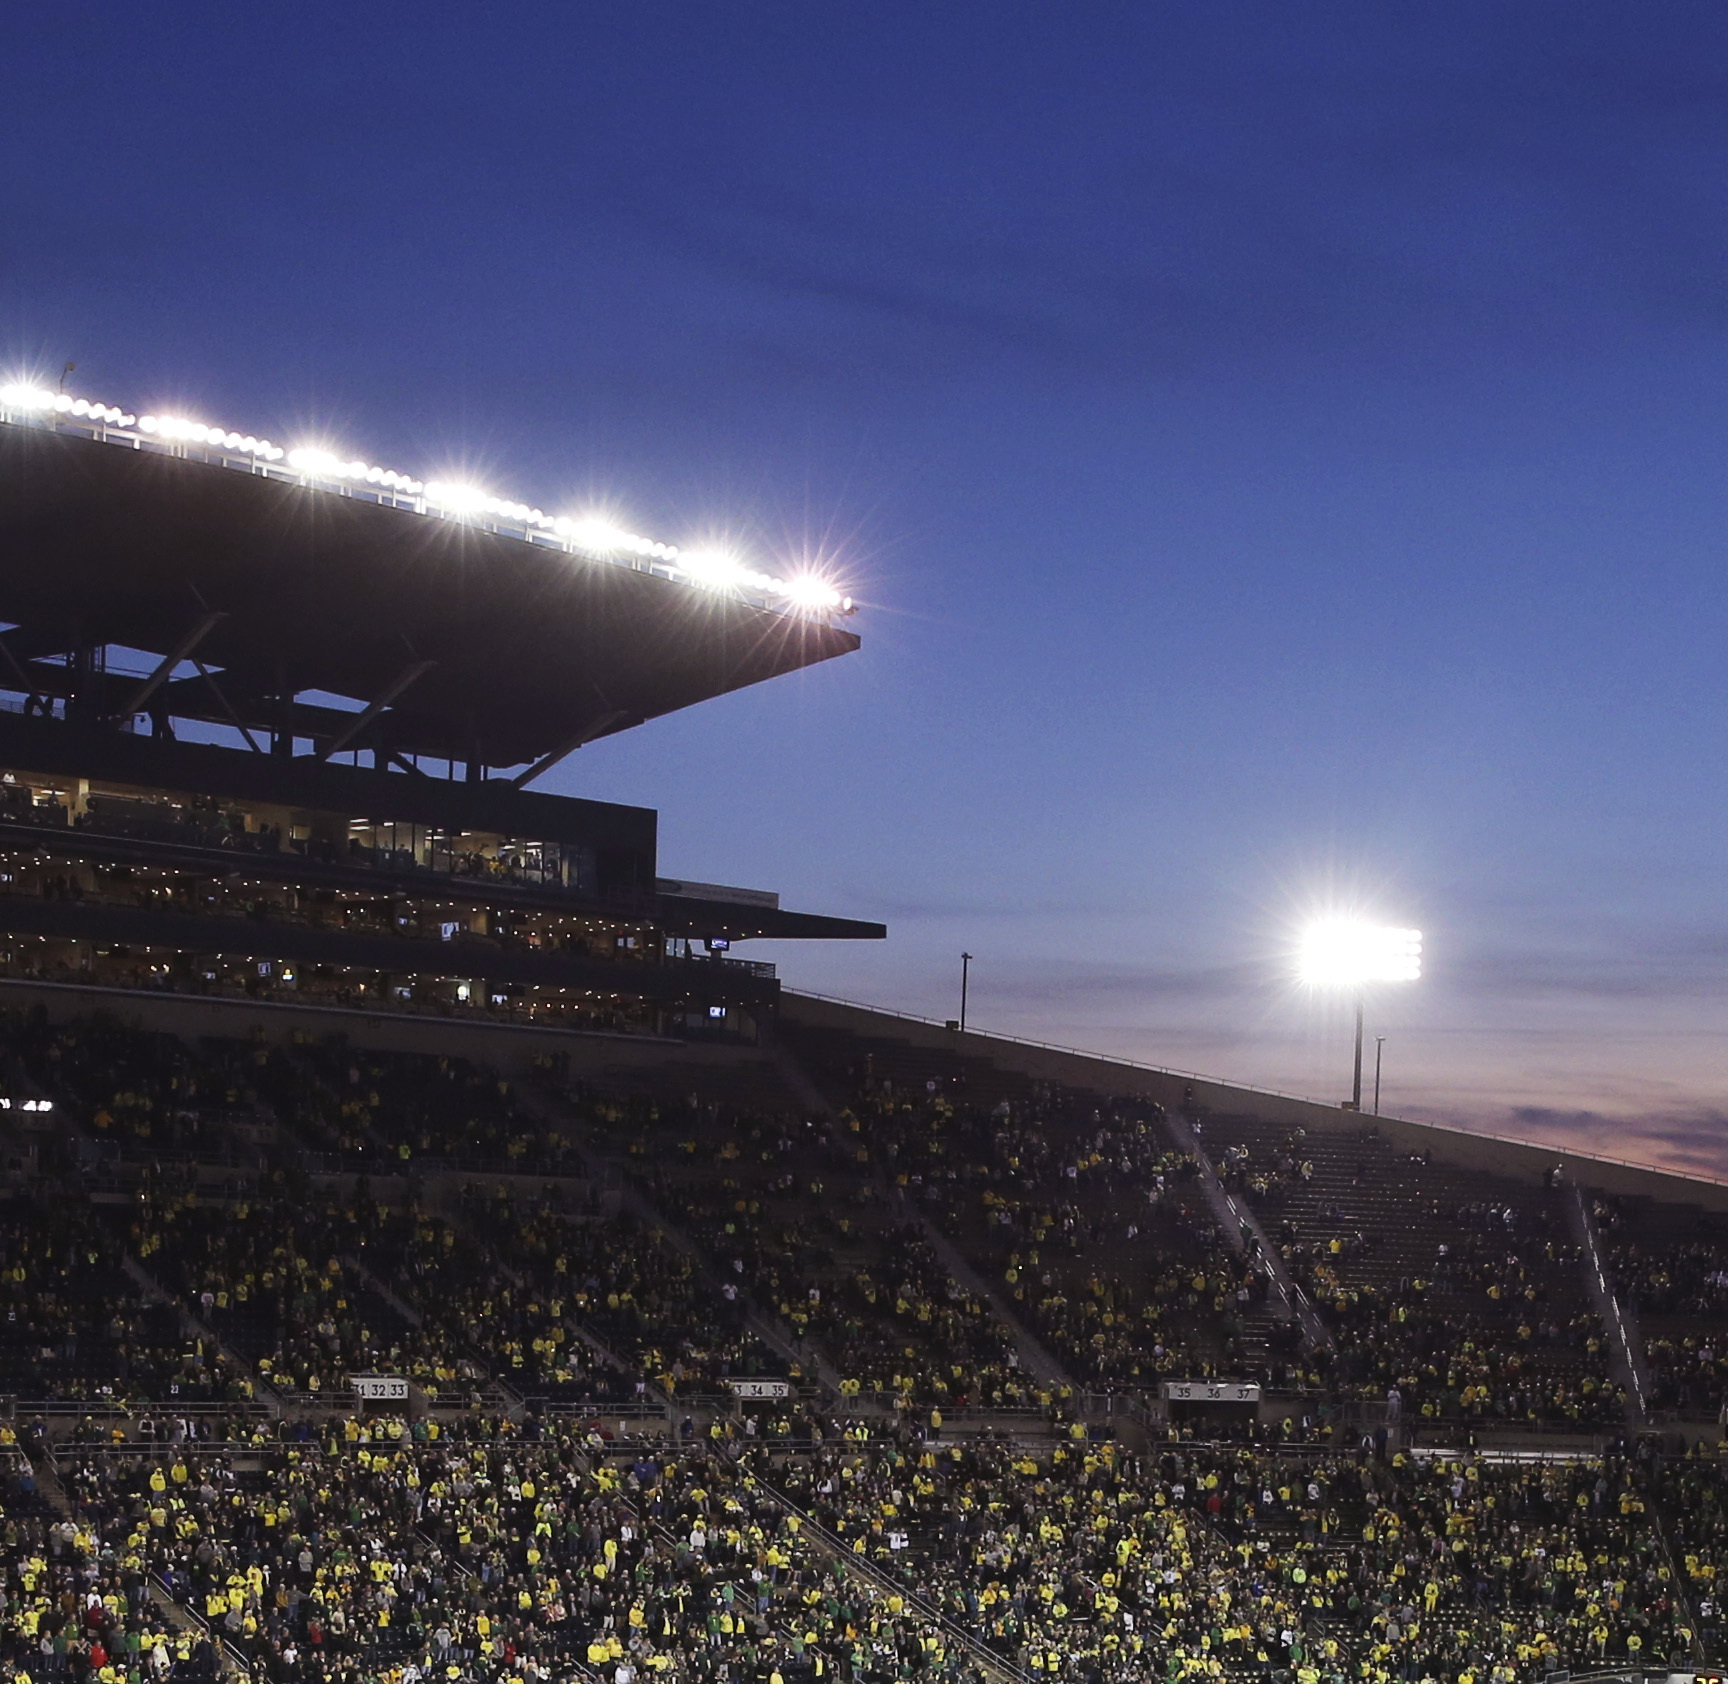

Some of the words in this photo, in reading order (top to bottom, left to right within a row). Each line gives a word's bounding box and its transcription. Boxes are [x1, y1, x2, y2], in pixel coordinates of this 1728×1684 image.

[371, 1384, 385, 1396] 32
[390, 1384, 405, 1396] 33
[751, 1385, 763, 1396] 34
[772, 1385, 783, 1396] 35
[1178, 1388, 1190, 1398] 35
[1208, 1388, 1220, 1399] 36
[1238, 1389, 1250, 1399] 37
